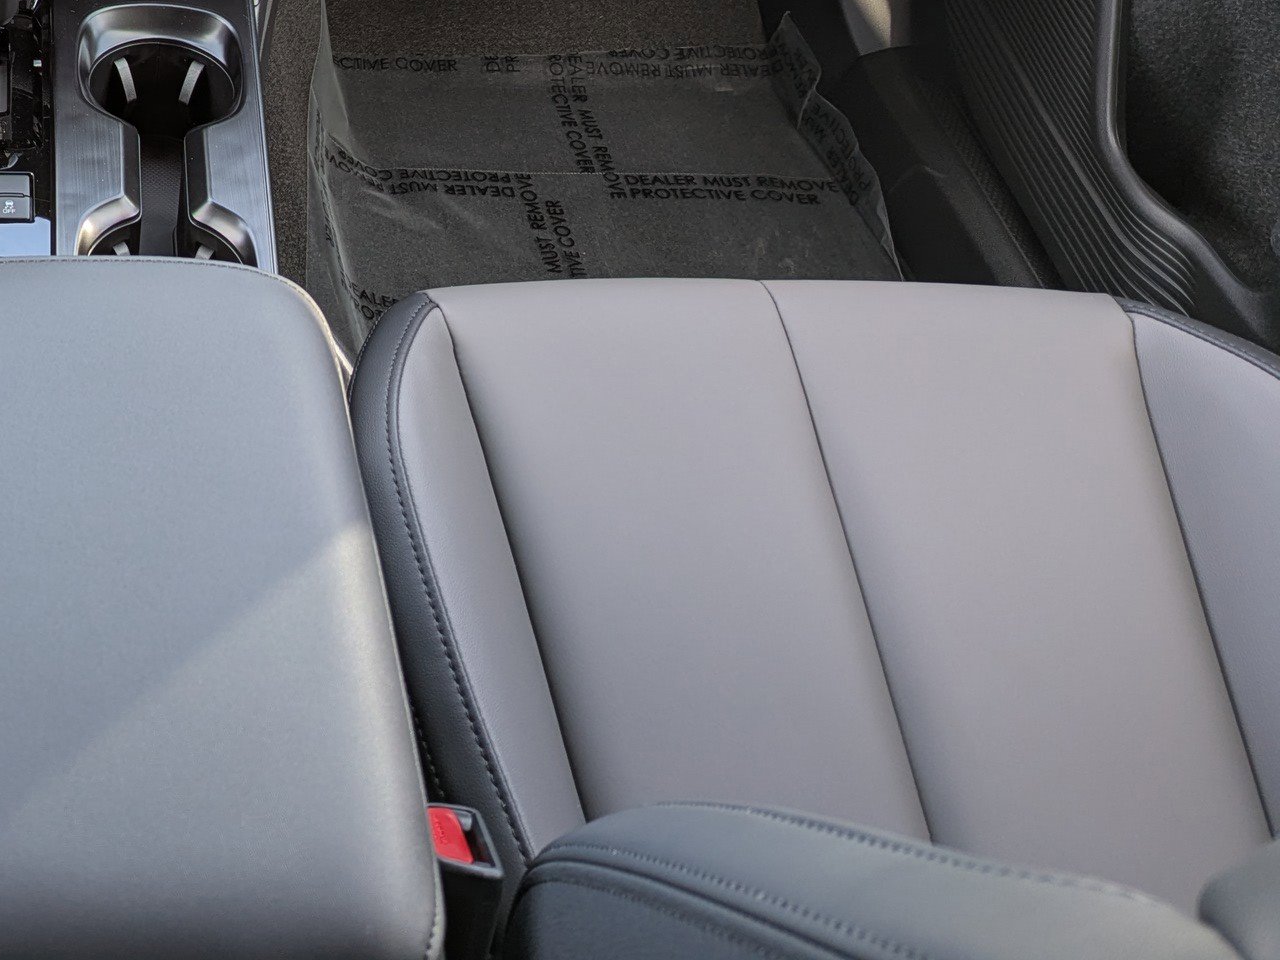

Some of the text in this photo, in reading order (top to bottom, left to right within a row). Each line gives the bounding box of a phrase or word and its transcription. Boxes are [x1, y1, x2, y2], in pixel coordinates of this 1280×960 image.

[395, 57, 458, 72] COVER
[566, 130, 596, 174] COVER
[577, 108, 627, 199] MUST REMOVE
[399, 168, 512, 183] PROTECTIVE
[624, 175, 840, 192] DEALER MUST REMOVE
[390, 180, 516, 198] DEALER MUST
[630, 188, 821, 205] PROTECTIVE COVER
[514, 173, 563, 274] MUST REMOVE
[545, 199, 575, 248] COVER
